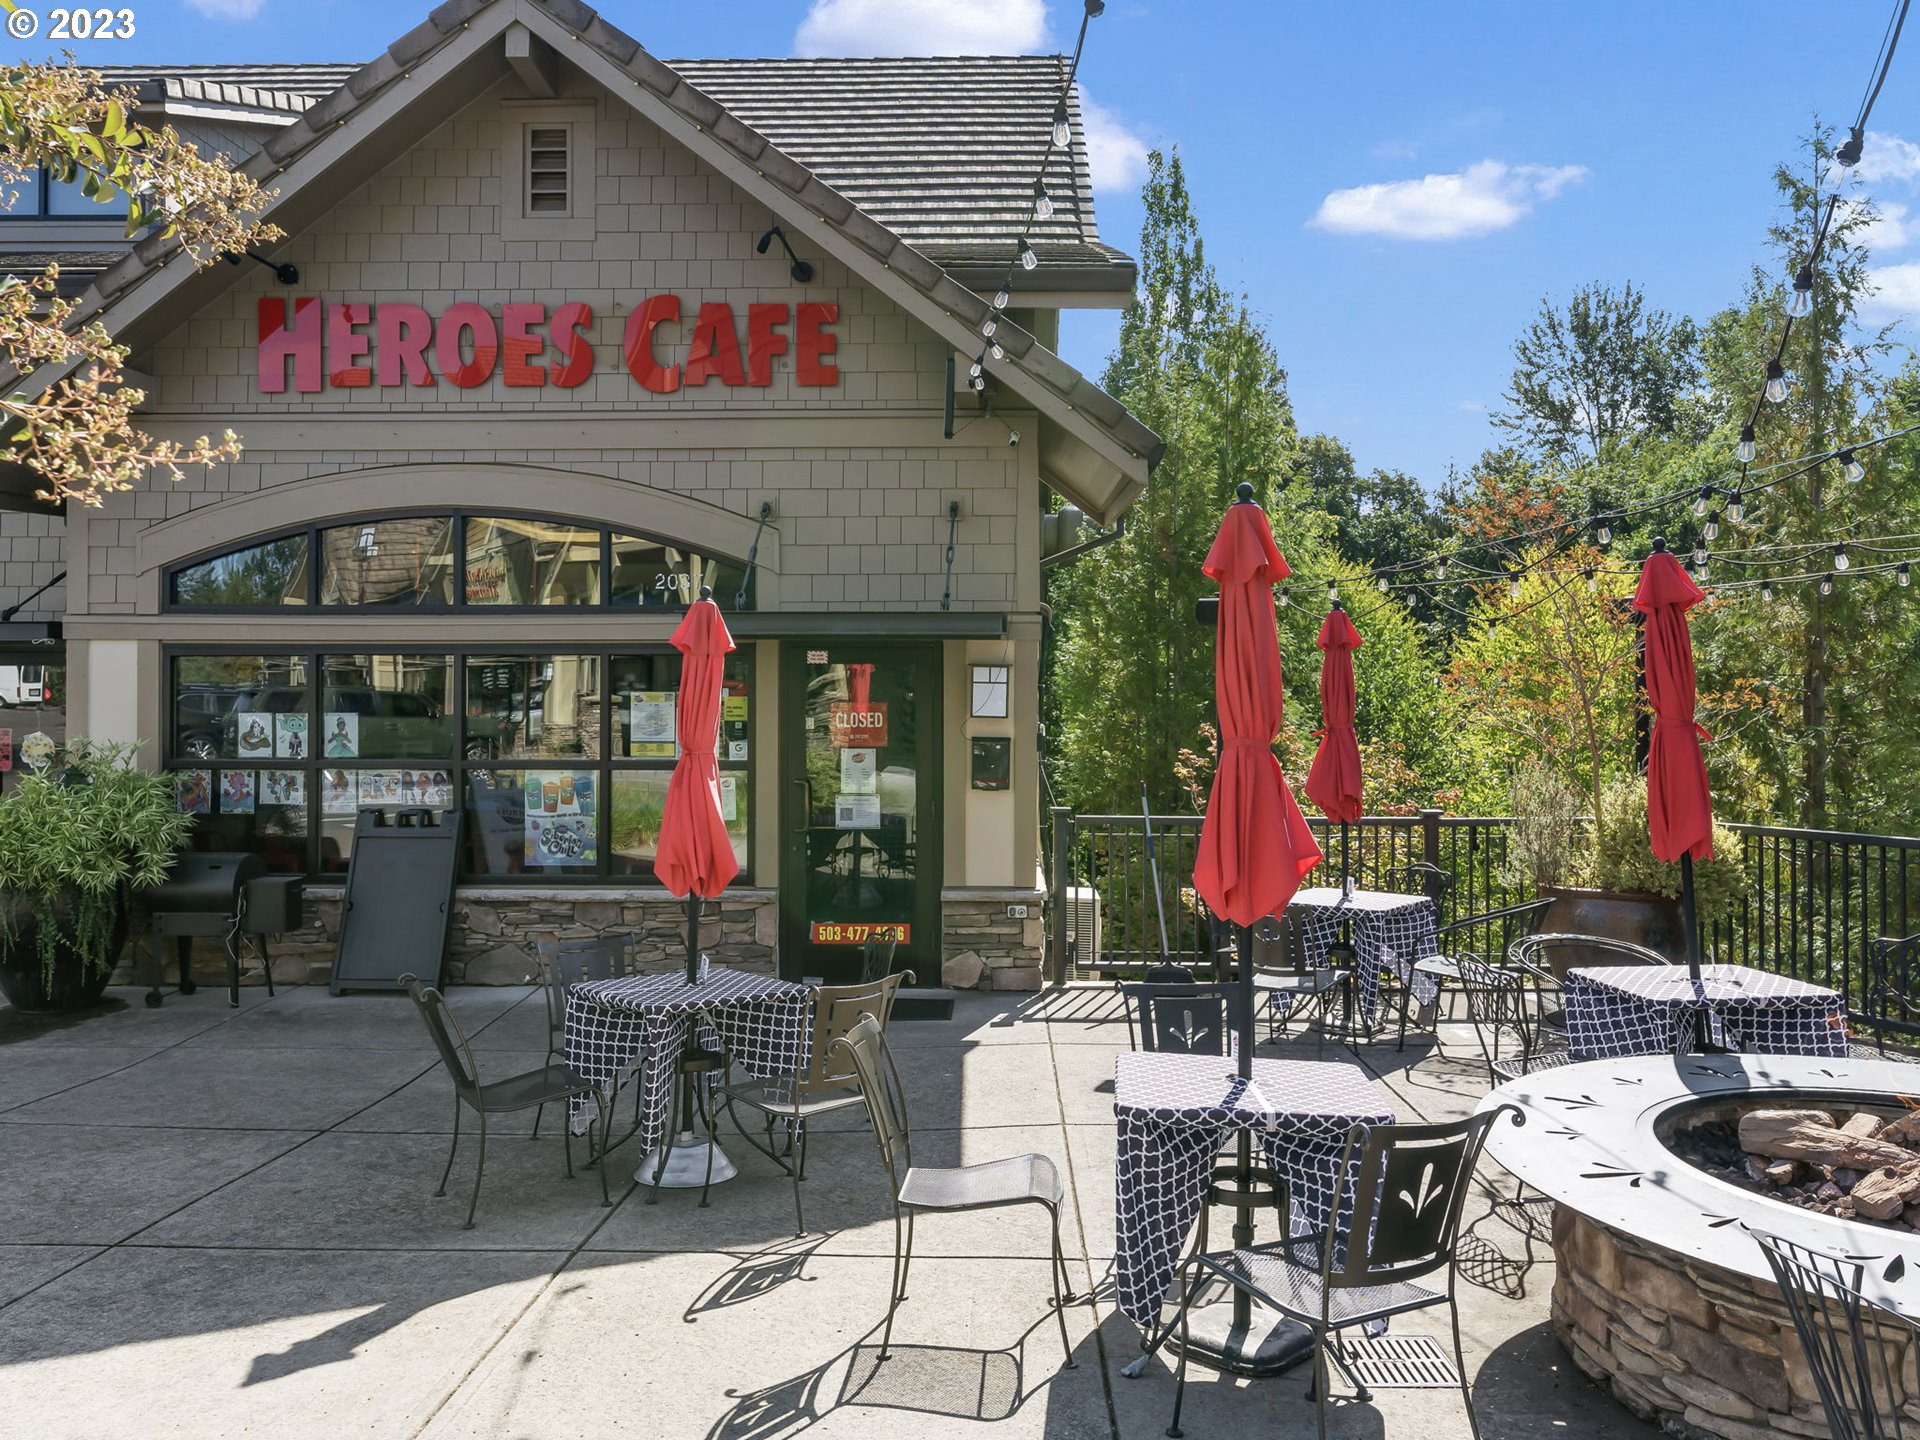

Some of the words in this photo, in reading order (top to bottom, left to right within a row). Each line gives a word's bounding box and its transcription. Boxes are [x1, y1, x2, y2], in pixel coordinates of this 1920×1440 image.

[258, 297, 595, 393] HEROES
[624, 294, 839, 393] CAFE
[835, 711, 883, 728] CLOSED
[540, 827, 582, 849] Siberian
[818, 926, 905, 941] 503-47746
